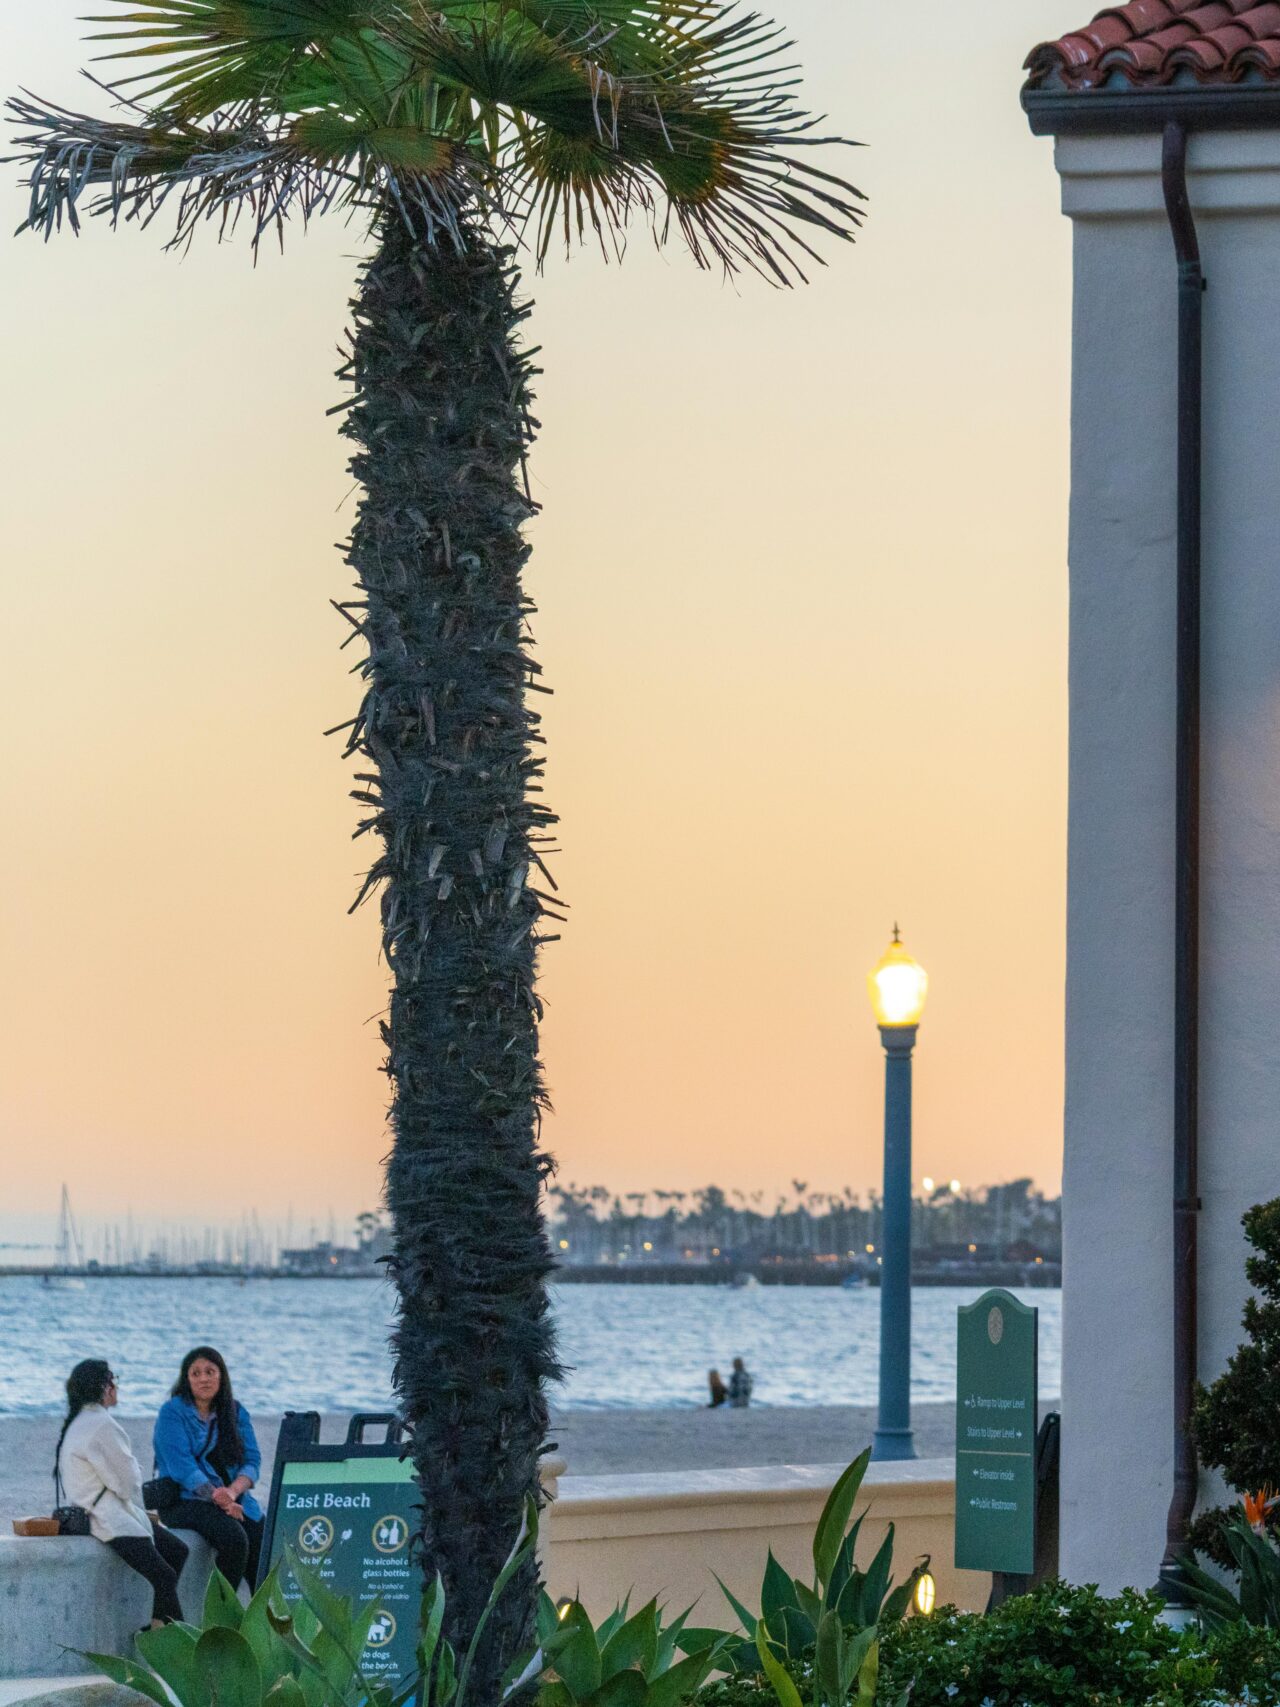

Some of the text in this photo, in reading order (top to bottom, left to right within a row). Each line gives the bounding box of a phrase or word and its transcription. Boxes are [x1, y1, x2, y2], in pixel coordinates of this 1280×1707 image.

[997, 1398, 1012, 1411] Upper
[1012, 1398, 1025, 1409] Level
[987, 1427, 1002, 1439] Upper
[1002, 1427, 1015, 1438] Level
[286, 1492, 371, 1508] East Beach
[363, 1557, 375, 1566] No
[375, 1557, 403, 1566] alcohol
[383, 1568, 410, 1577] bottles
[371, 1650, 391, 1660] dogs
[361, 1661, 375, 1670] the
